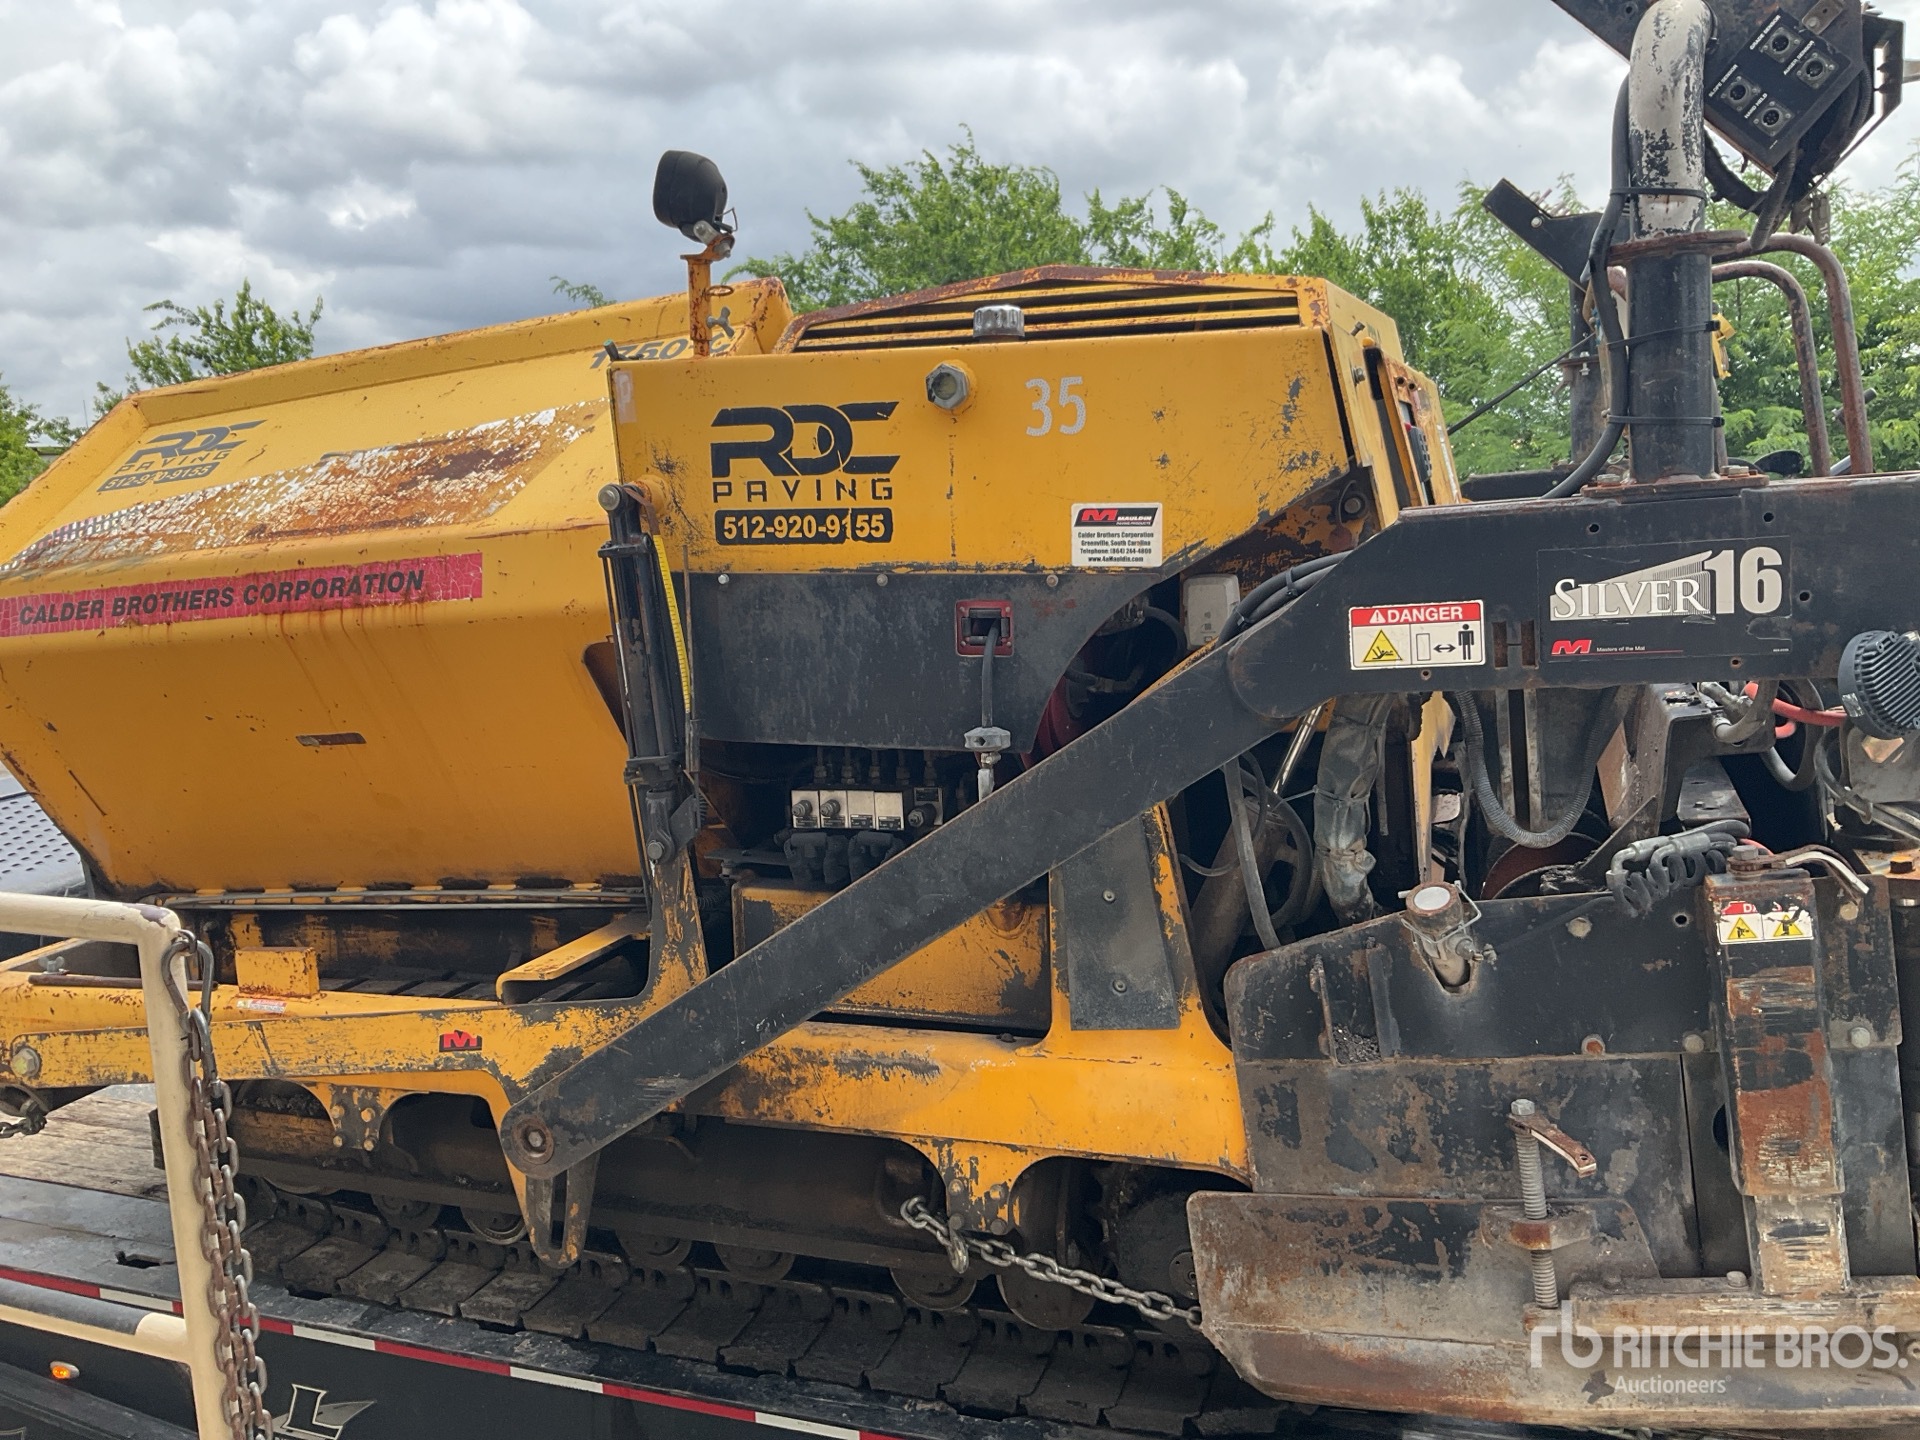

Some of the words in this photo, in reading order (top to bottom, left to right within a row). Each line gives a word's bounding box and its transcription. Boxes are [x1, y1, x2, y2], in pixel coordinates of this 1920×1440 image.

[1749, 33, 1765, 50] GRADE
[1763, 14, 1781, 35] SENSOR
[1783, 58, 1798, 75] AUGER
[1796, 40, 1815, 60] SENSOR
[1708, 81, 1723, 97] SLOPE
[1720, 64, 1738, 83] SENSOR
[1744, 105, 1757, 119] HAND
[1755, 92, 1768, 107] HELD
[1025, 376, 1087, 437] 35
[114, 450, 231, 475] PAVING
[713, 478, 893, 503] PAVING
[723, 513, 885, 539] 512-920-9155
[19, 599, 105, 625] CALDER
[111, 586, 235, 618] BROTHERS
[243, 569, 425, 606] CORPORATION
[1553, 578, 1711, 619] SILVER
[1703, 546, 1783, 615] 16
[1387, 606, 1463, 624] DANGER
